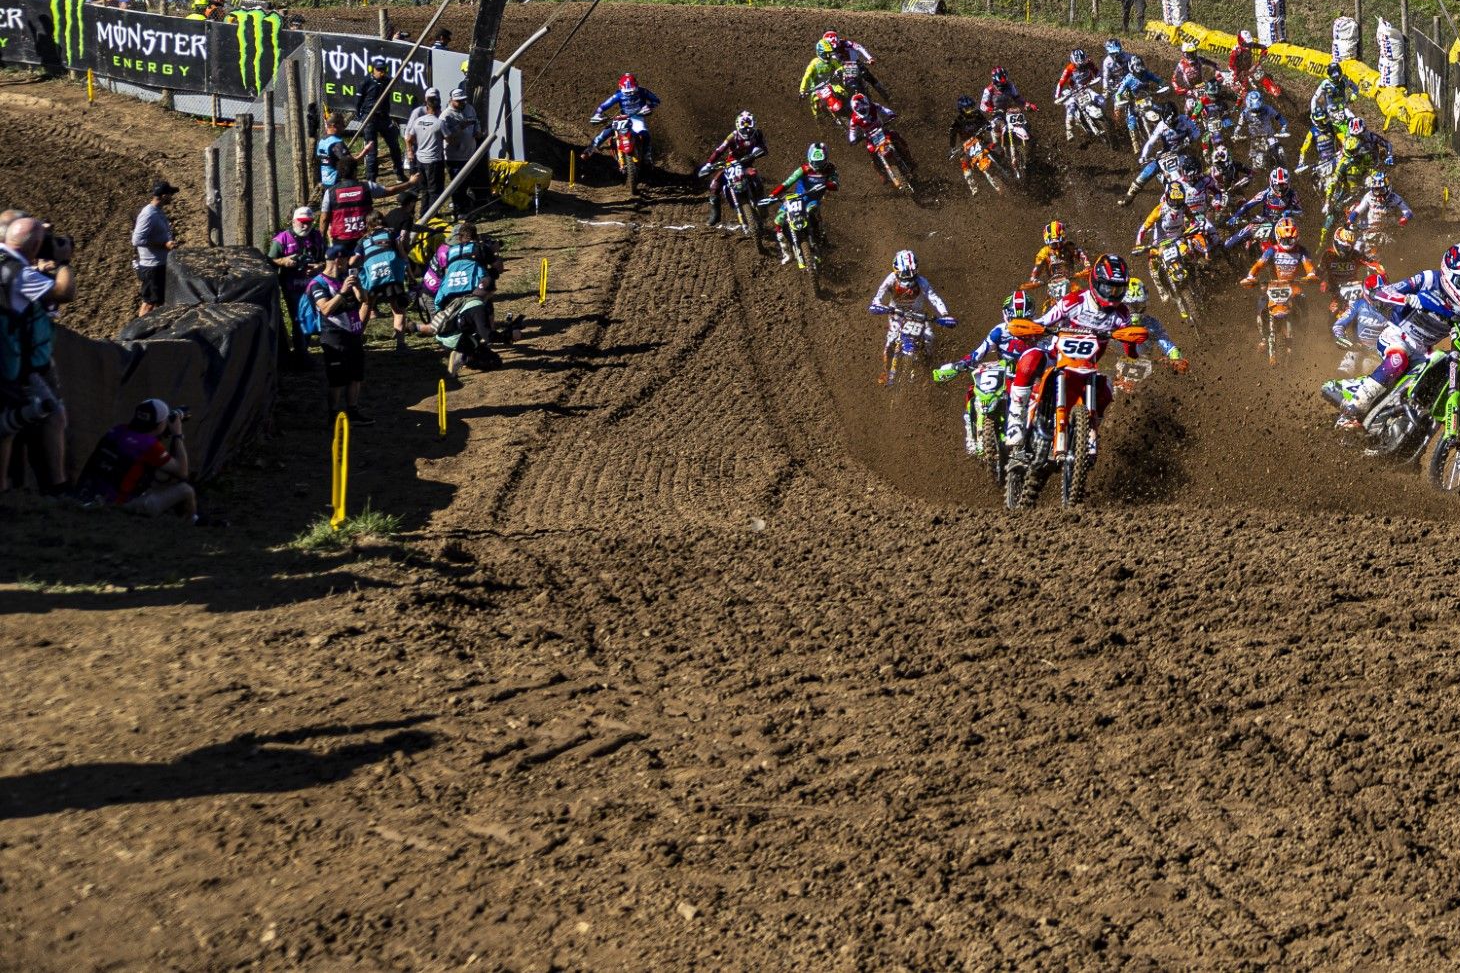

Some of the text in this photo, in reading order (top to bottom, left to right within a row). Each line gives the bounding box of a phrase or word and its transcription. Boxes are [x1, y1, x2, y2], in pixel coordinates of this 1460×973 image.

[96, 20, 207, 59] MONSTER
[113, 55, 190, 76] ENERGY
[322, 45, 428, 89] ONTER
[325, 83, 415, 105] ENGY
[1425, 66, 1441, 109] FOX
[727, 166, 742, 179] 26
[1063, 340, 1095, 355] 58
[980, 370, 999, 392] 5
